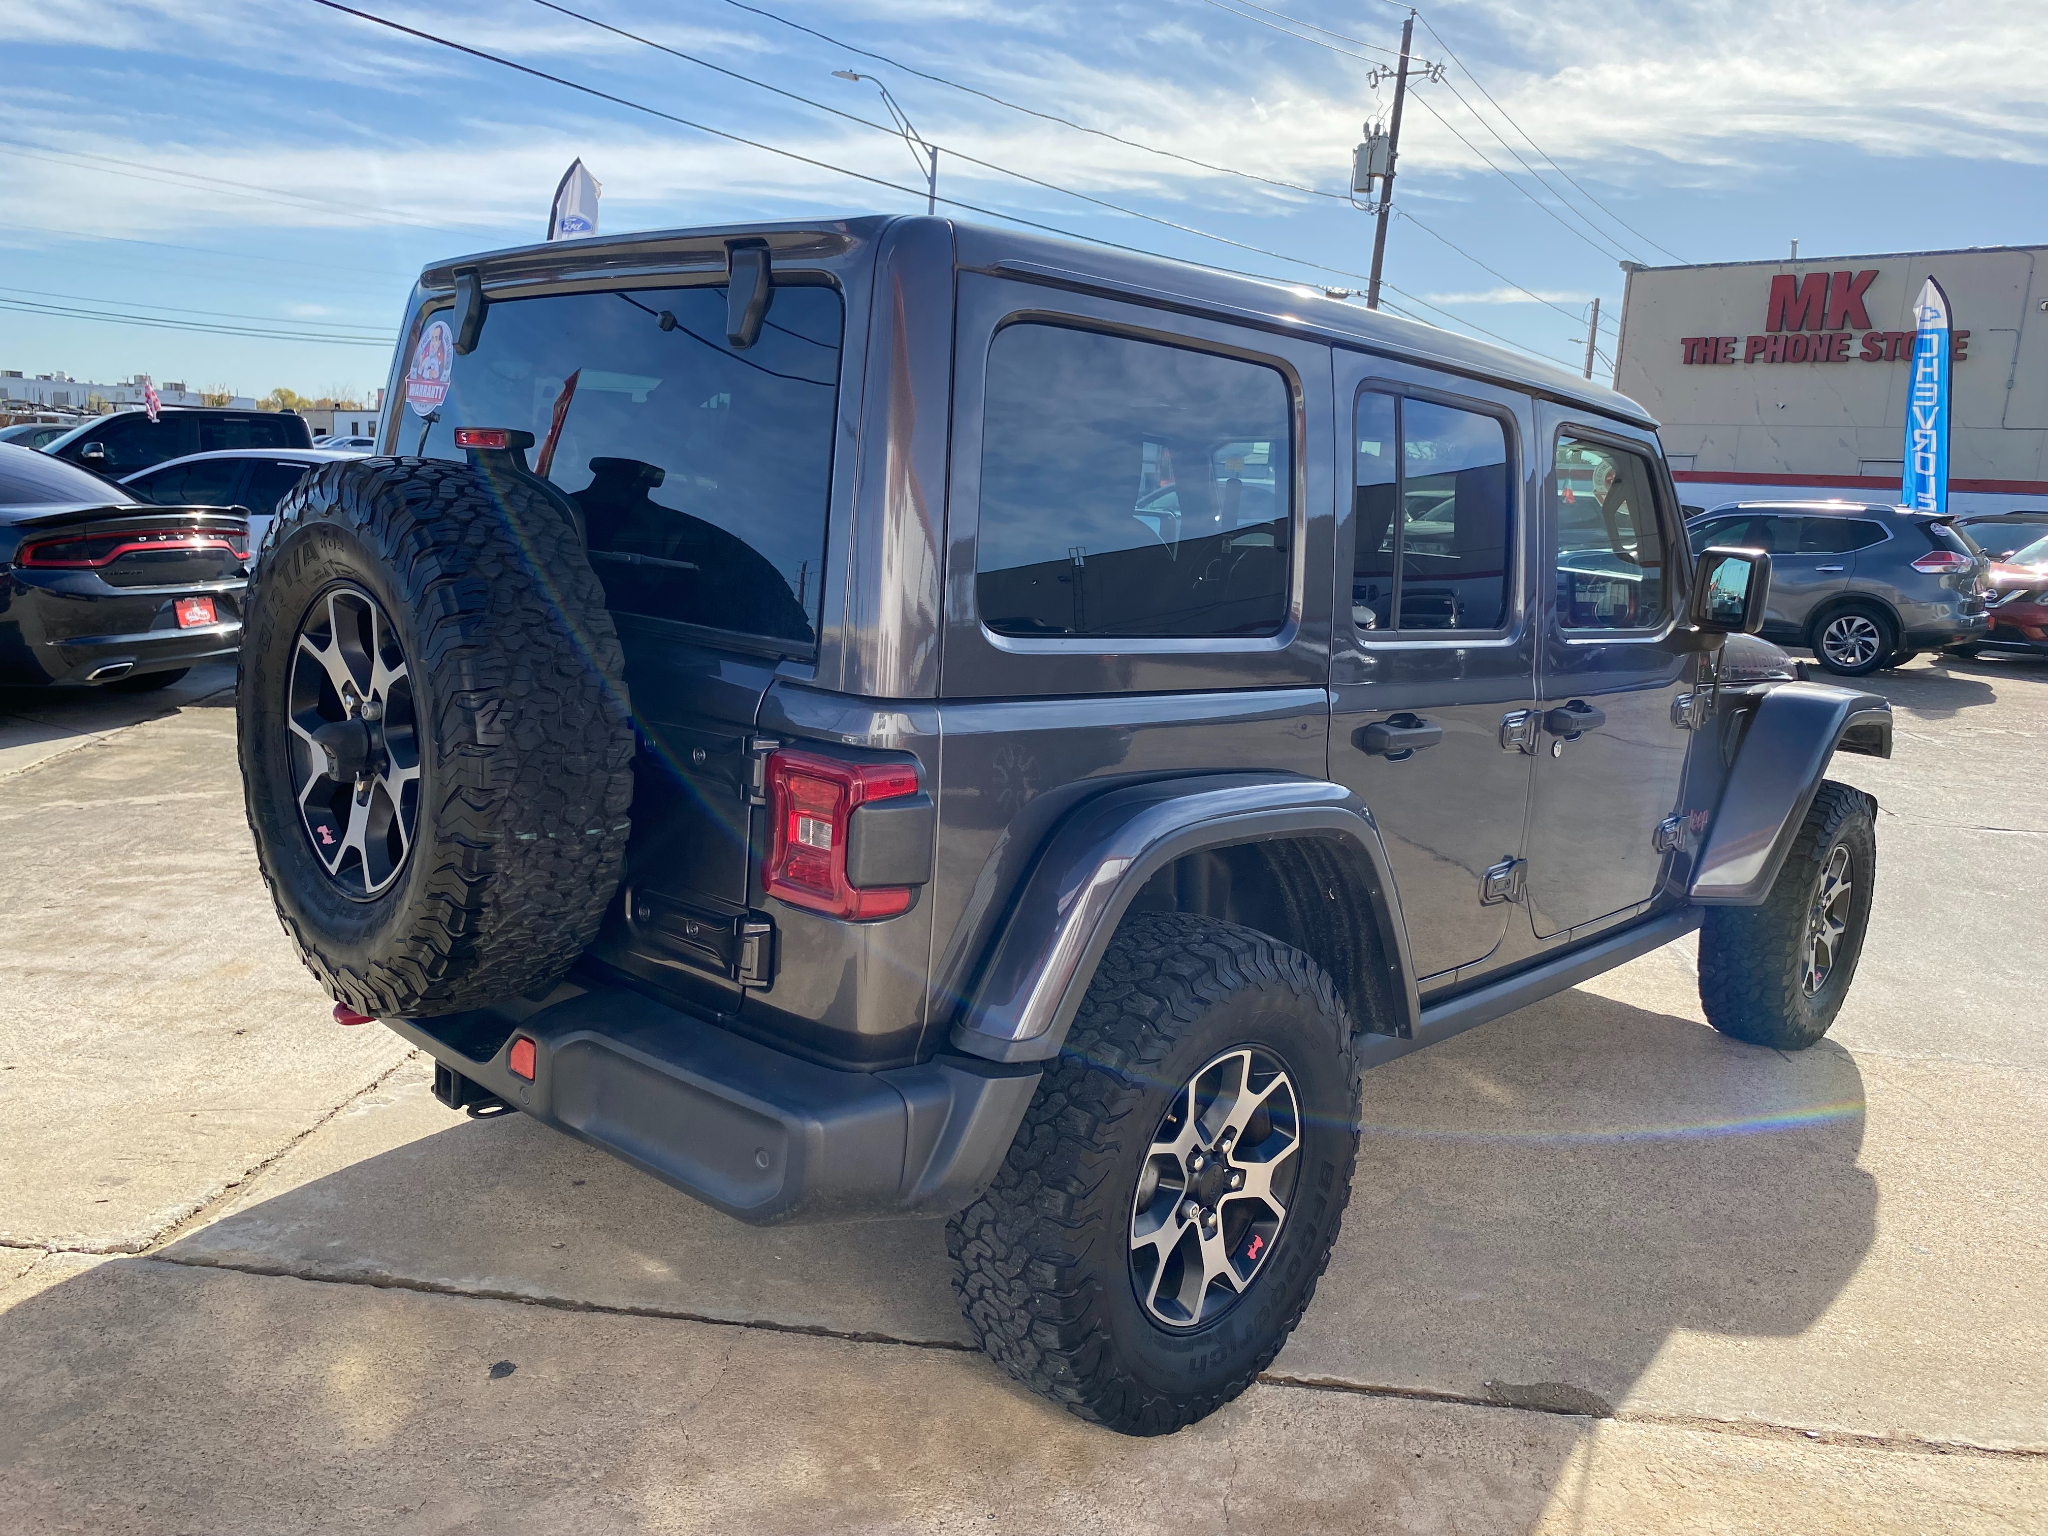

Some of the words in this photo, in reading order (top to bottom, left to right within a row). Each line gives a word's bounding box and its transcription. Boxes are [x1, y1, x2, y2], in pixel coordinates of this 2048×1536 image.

[1766, 269, 1880, 333] MK
[1681, 336, 1738, 365] THE
[1744, 332, 1853, 364] PHONE
[1859, 329, 1971, 363] STOE
[408, 383, 445, 400] WARRANTY
